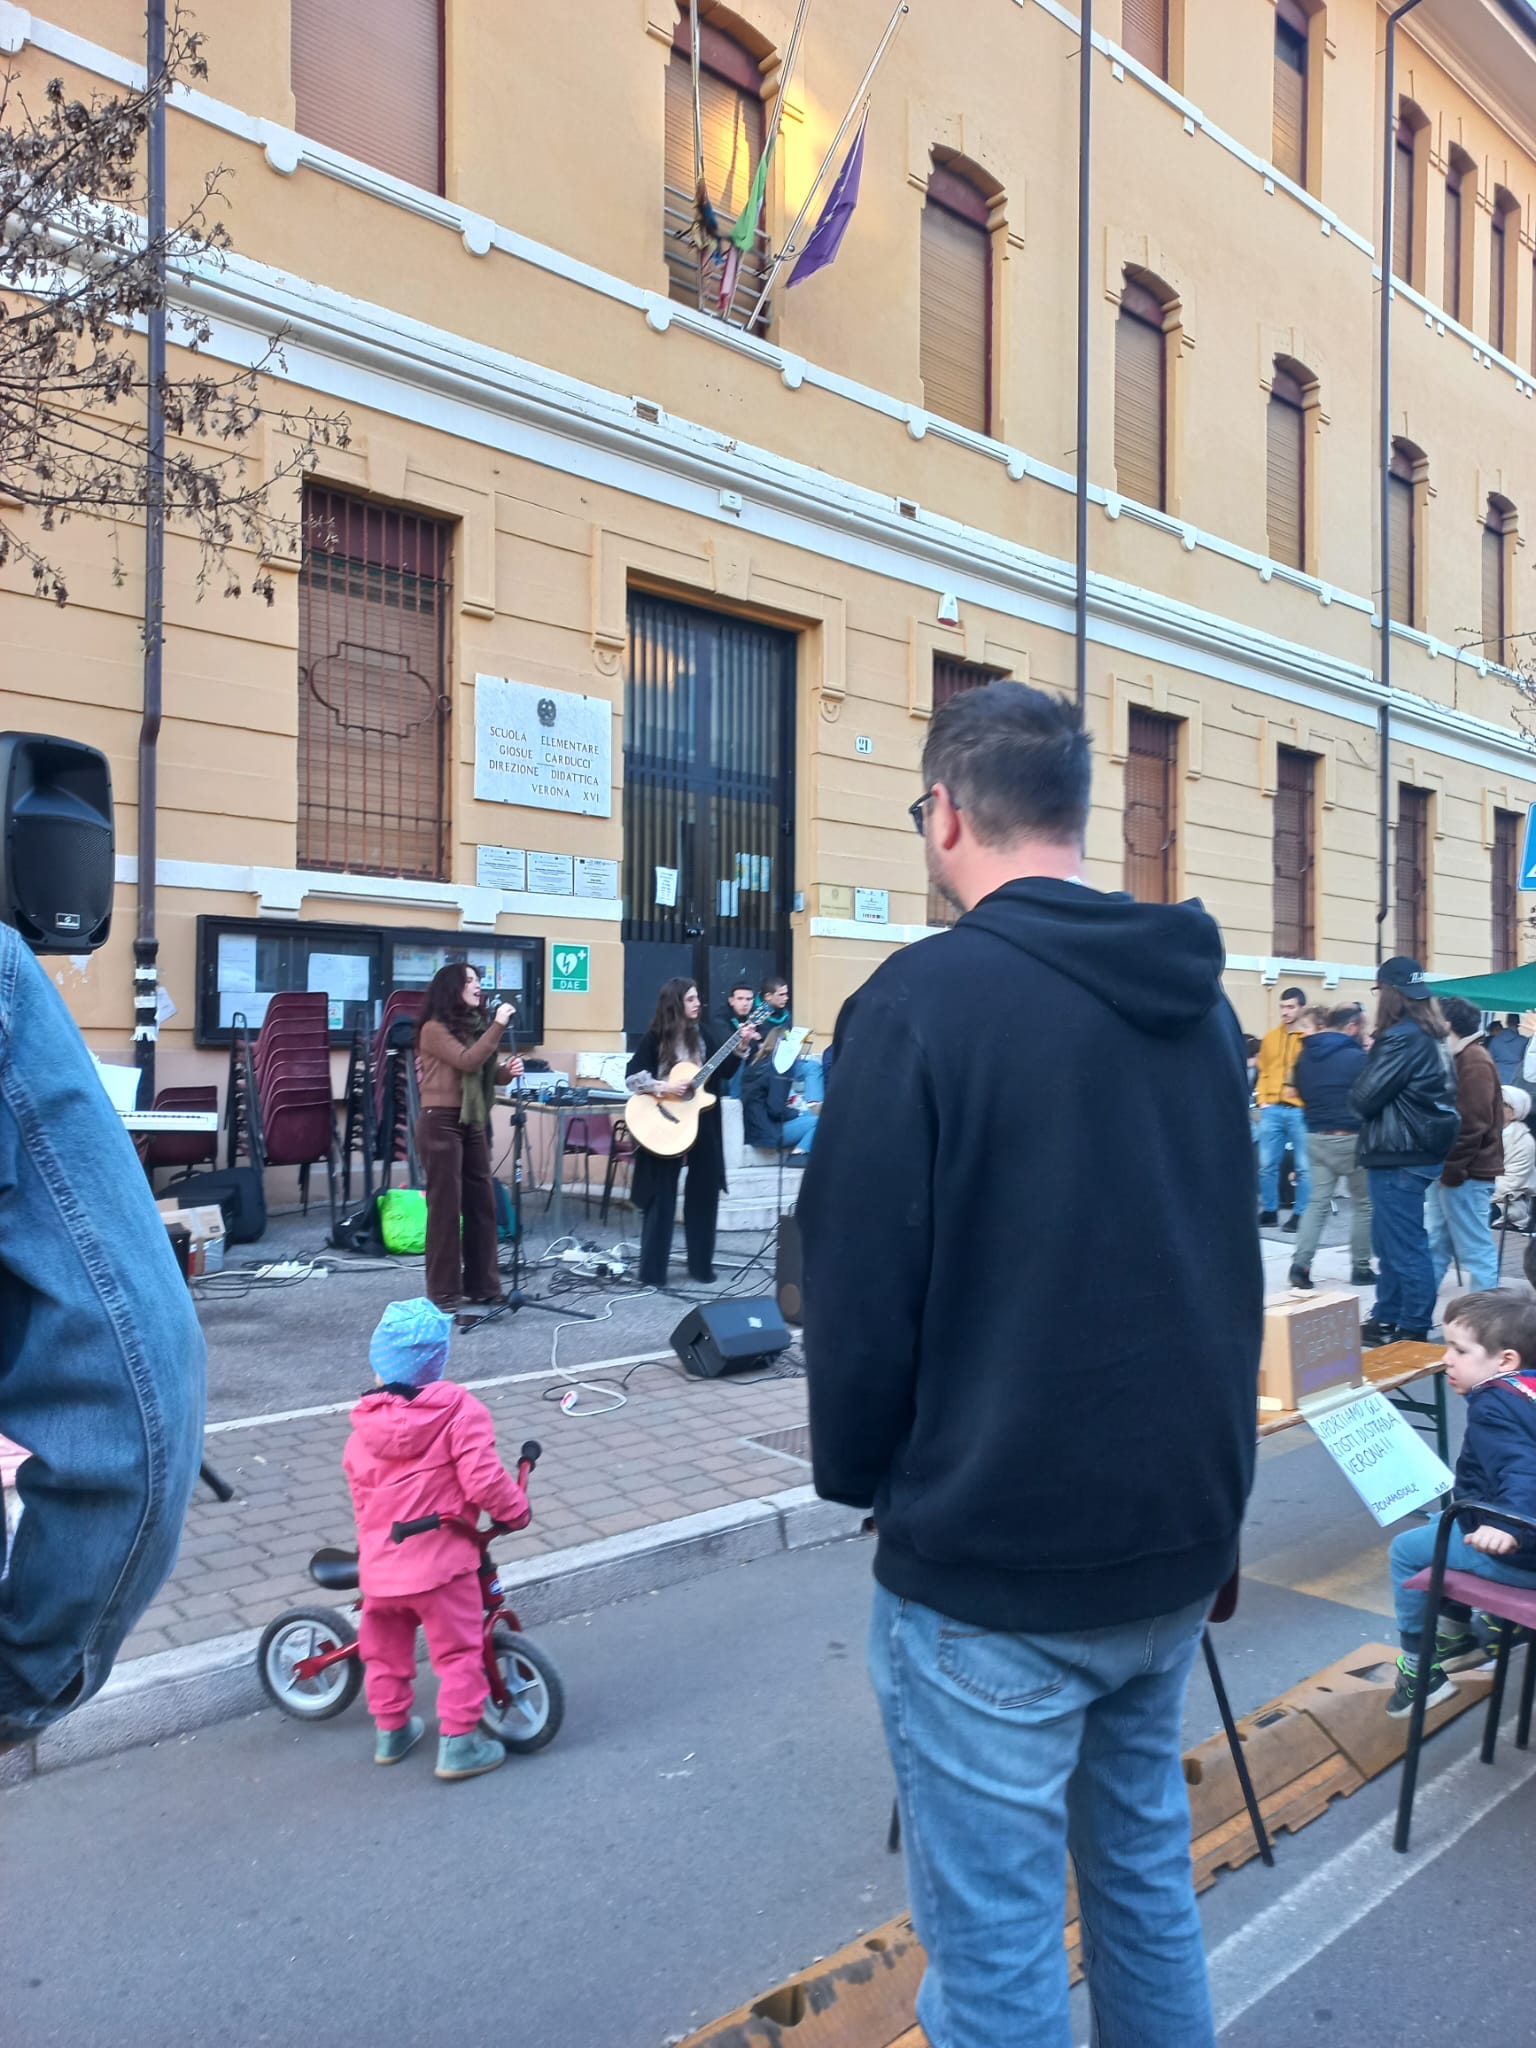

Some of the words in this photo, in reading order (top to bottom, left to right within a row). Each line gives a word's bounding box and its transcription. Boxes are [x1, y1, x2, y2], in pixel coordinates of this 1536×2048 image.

[490, 726, 527, 742] SCUOLA
[541, 735, 599, 755] ELEMENTARE
[545, 752, 592, 769] CARDUCCI
[489, 759, 539, 777] DIREZIONE
[551, 769, 599, 786] DIDATTICA
[531, 783, 570, 798] VERONA
[583, 790, 600, 803] XVI
[559, 980, 580, 990] DAE
